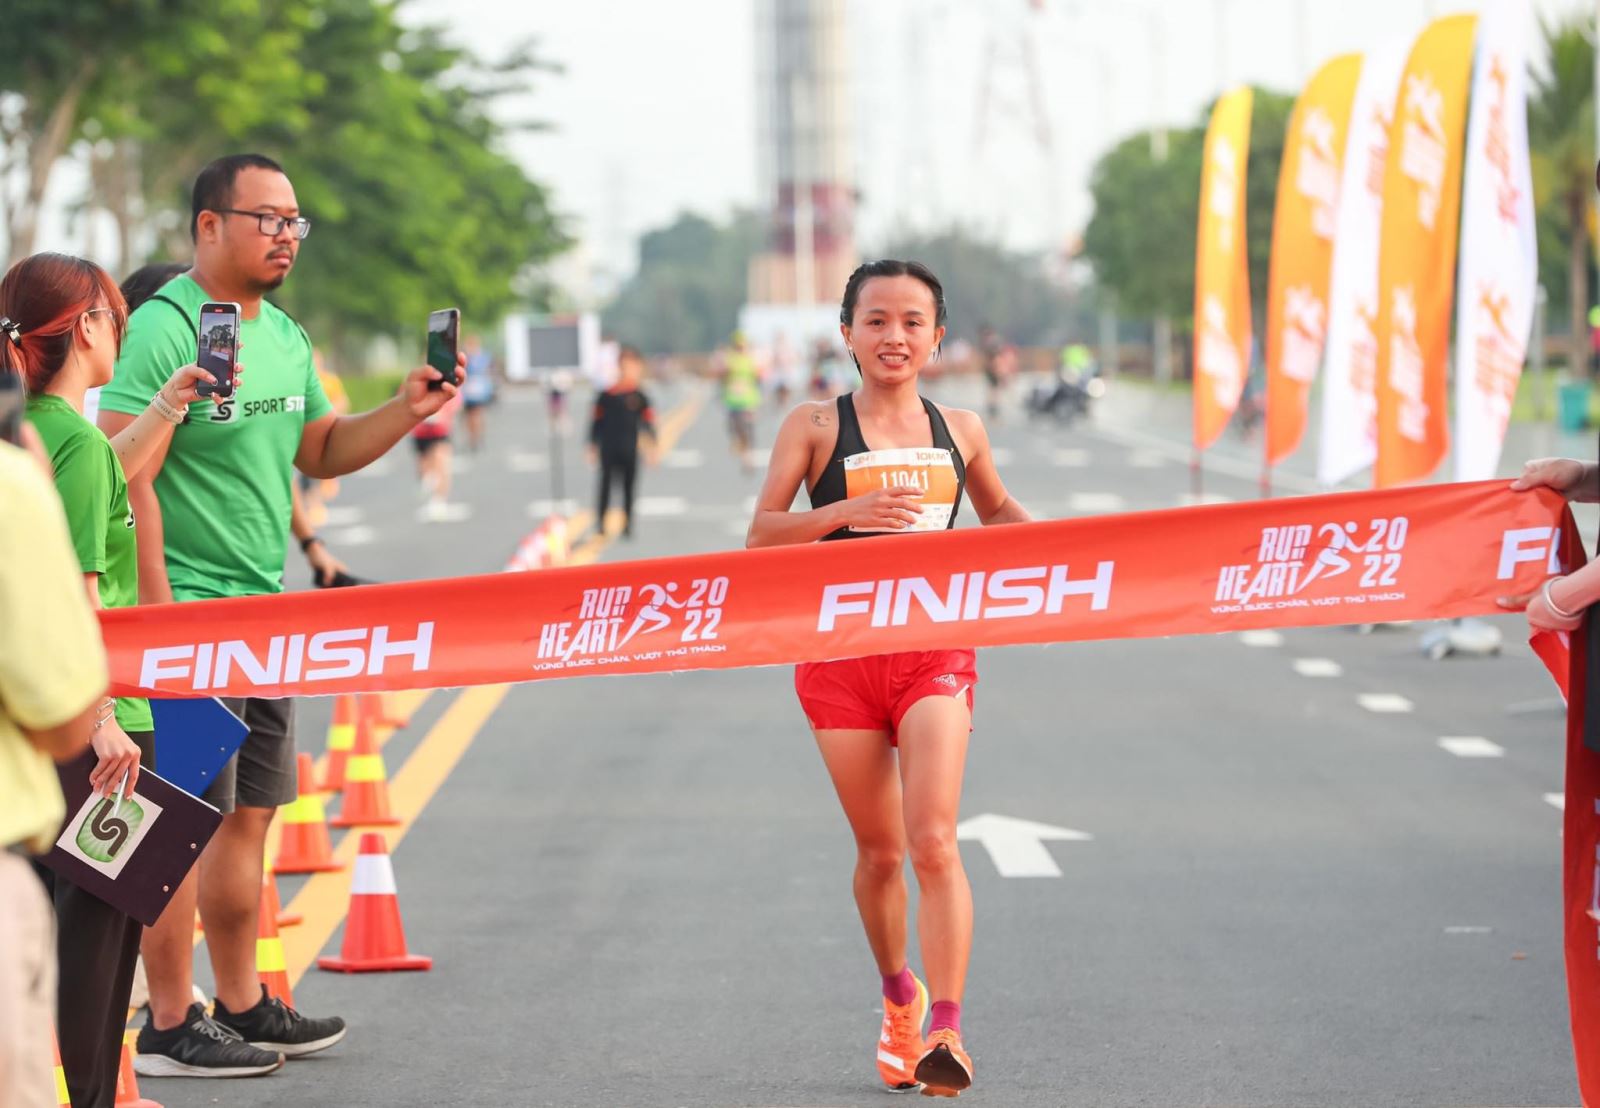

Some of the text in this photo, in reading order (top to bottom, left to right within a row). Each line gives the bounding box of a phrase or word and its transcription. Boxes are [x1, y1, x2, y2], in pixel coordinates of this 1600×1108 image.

[880, 470, 929, 491] 11041
[1366, 516, 1409, 552] 20
[1215, 561, 1304, 604] HEART
[1359, 552, 1402, 588] 22
[687, 576, 730, 608] 20
[816, 561, 1115, 632] FINISH
[537, 617, 624, 662] HEART
[680, 607, 723, 642] 22
[138, 621, 435, 690] FINISH
